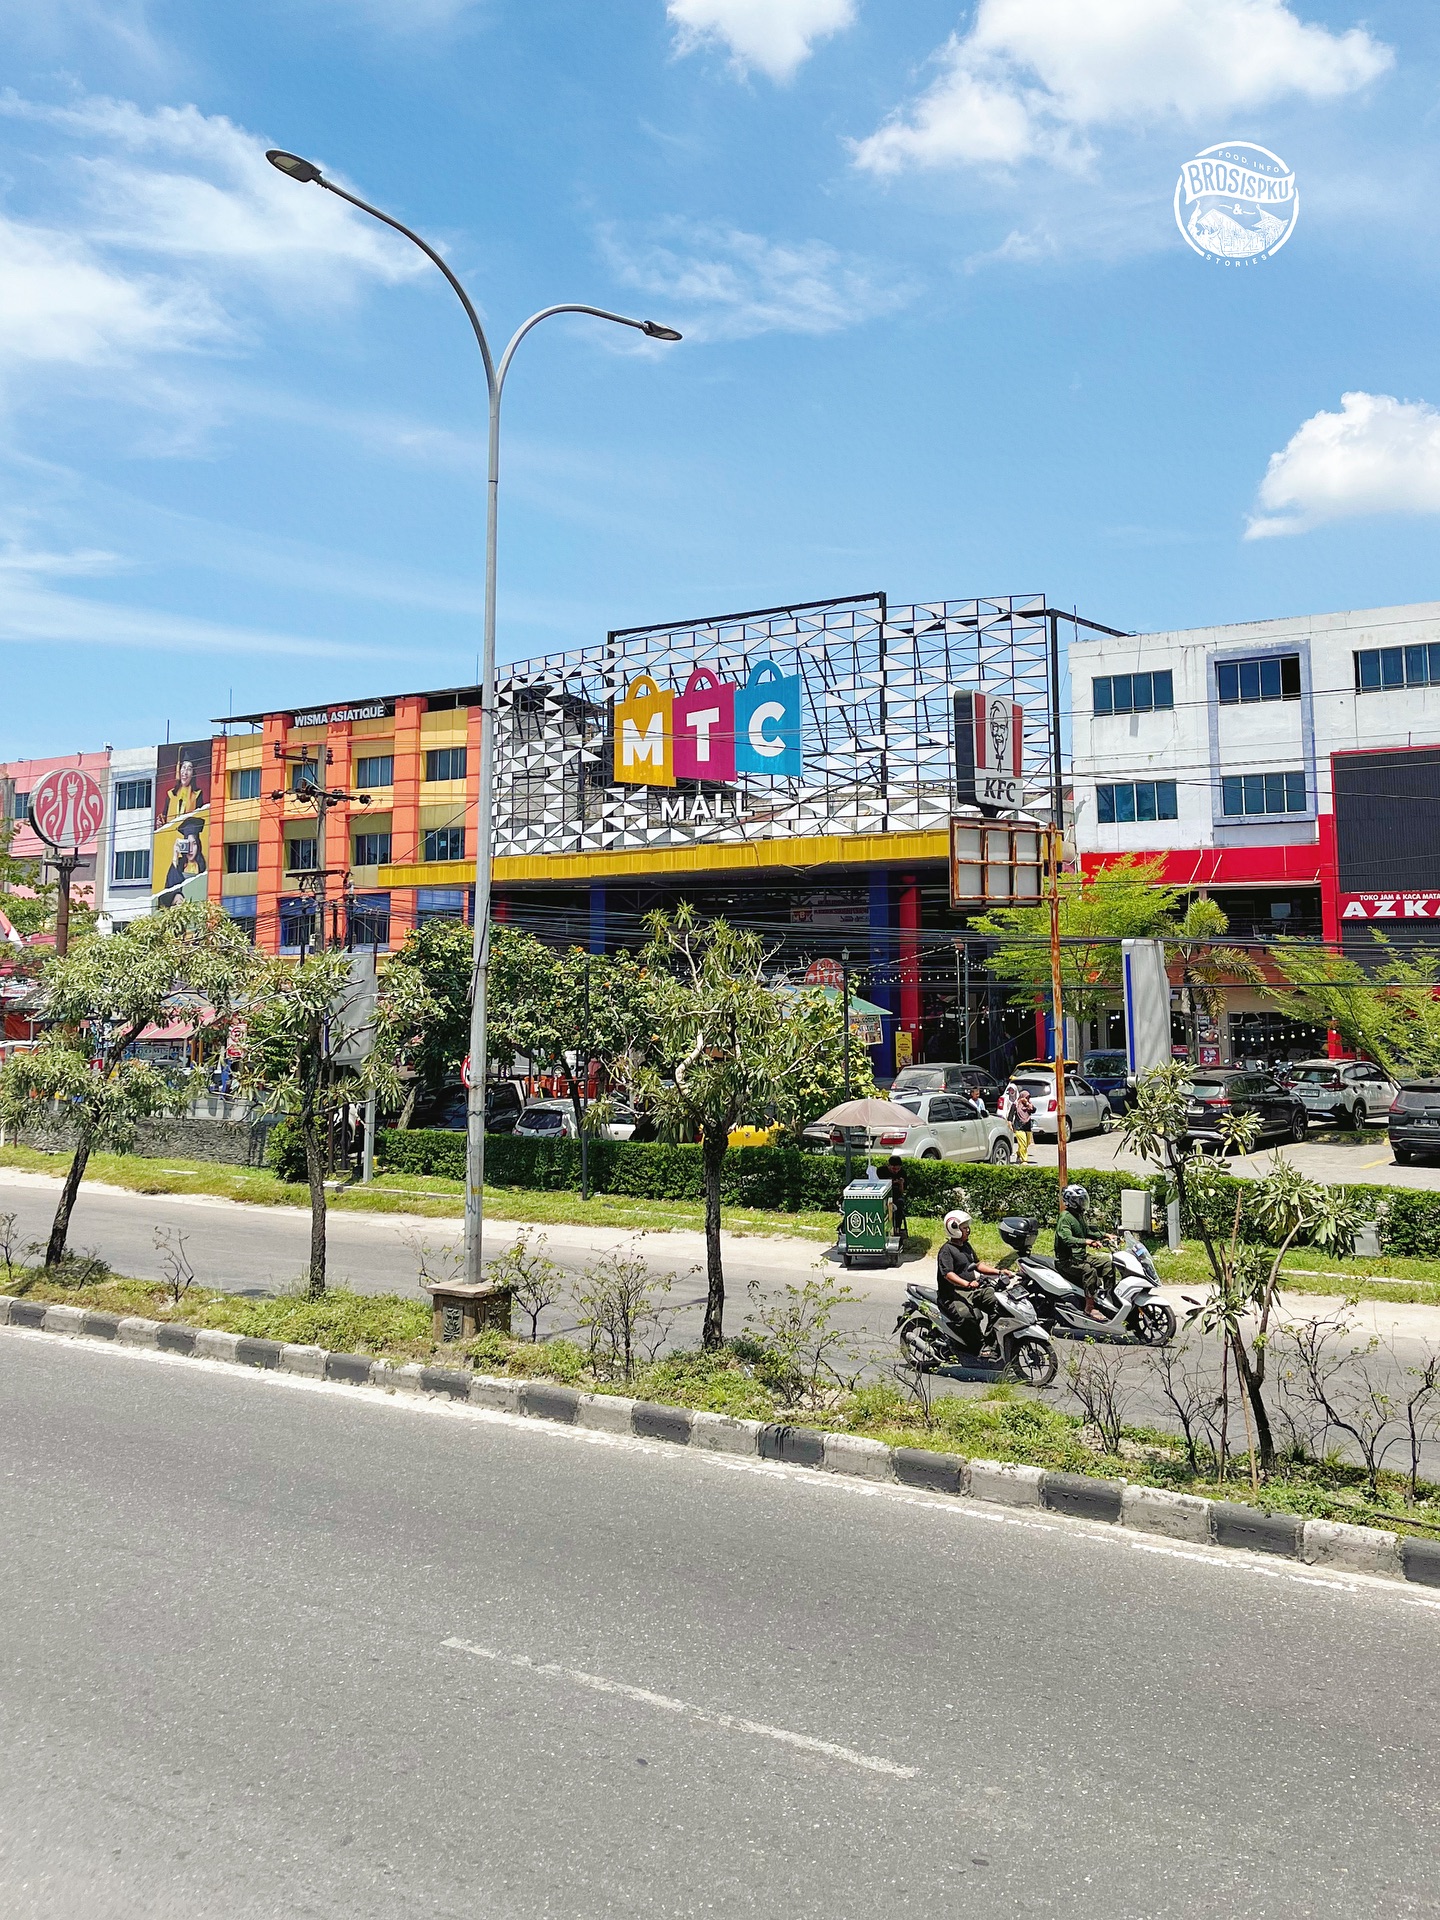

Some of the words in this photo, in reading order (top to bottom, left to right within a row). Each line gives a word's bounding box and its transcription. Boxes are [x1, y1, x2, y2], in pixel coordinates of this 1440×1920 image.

[295, 713, 328, 727] WISMA
[330, 706, 385, 723] ASIATIQUE
[622, 701, 786, 766] MTC
[984, 777, 1016, 803] KFC
[661, 791, 755, 822] MALL
[1342, 900, 1440, 918] AZK
